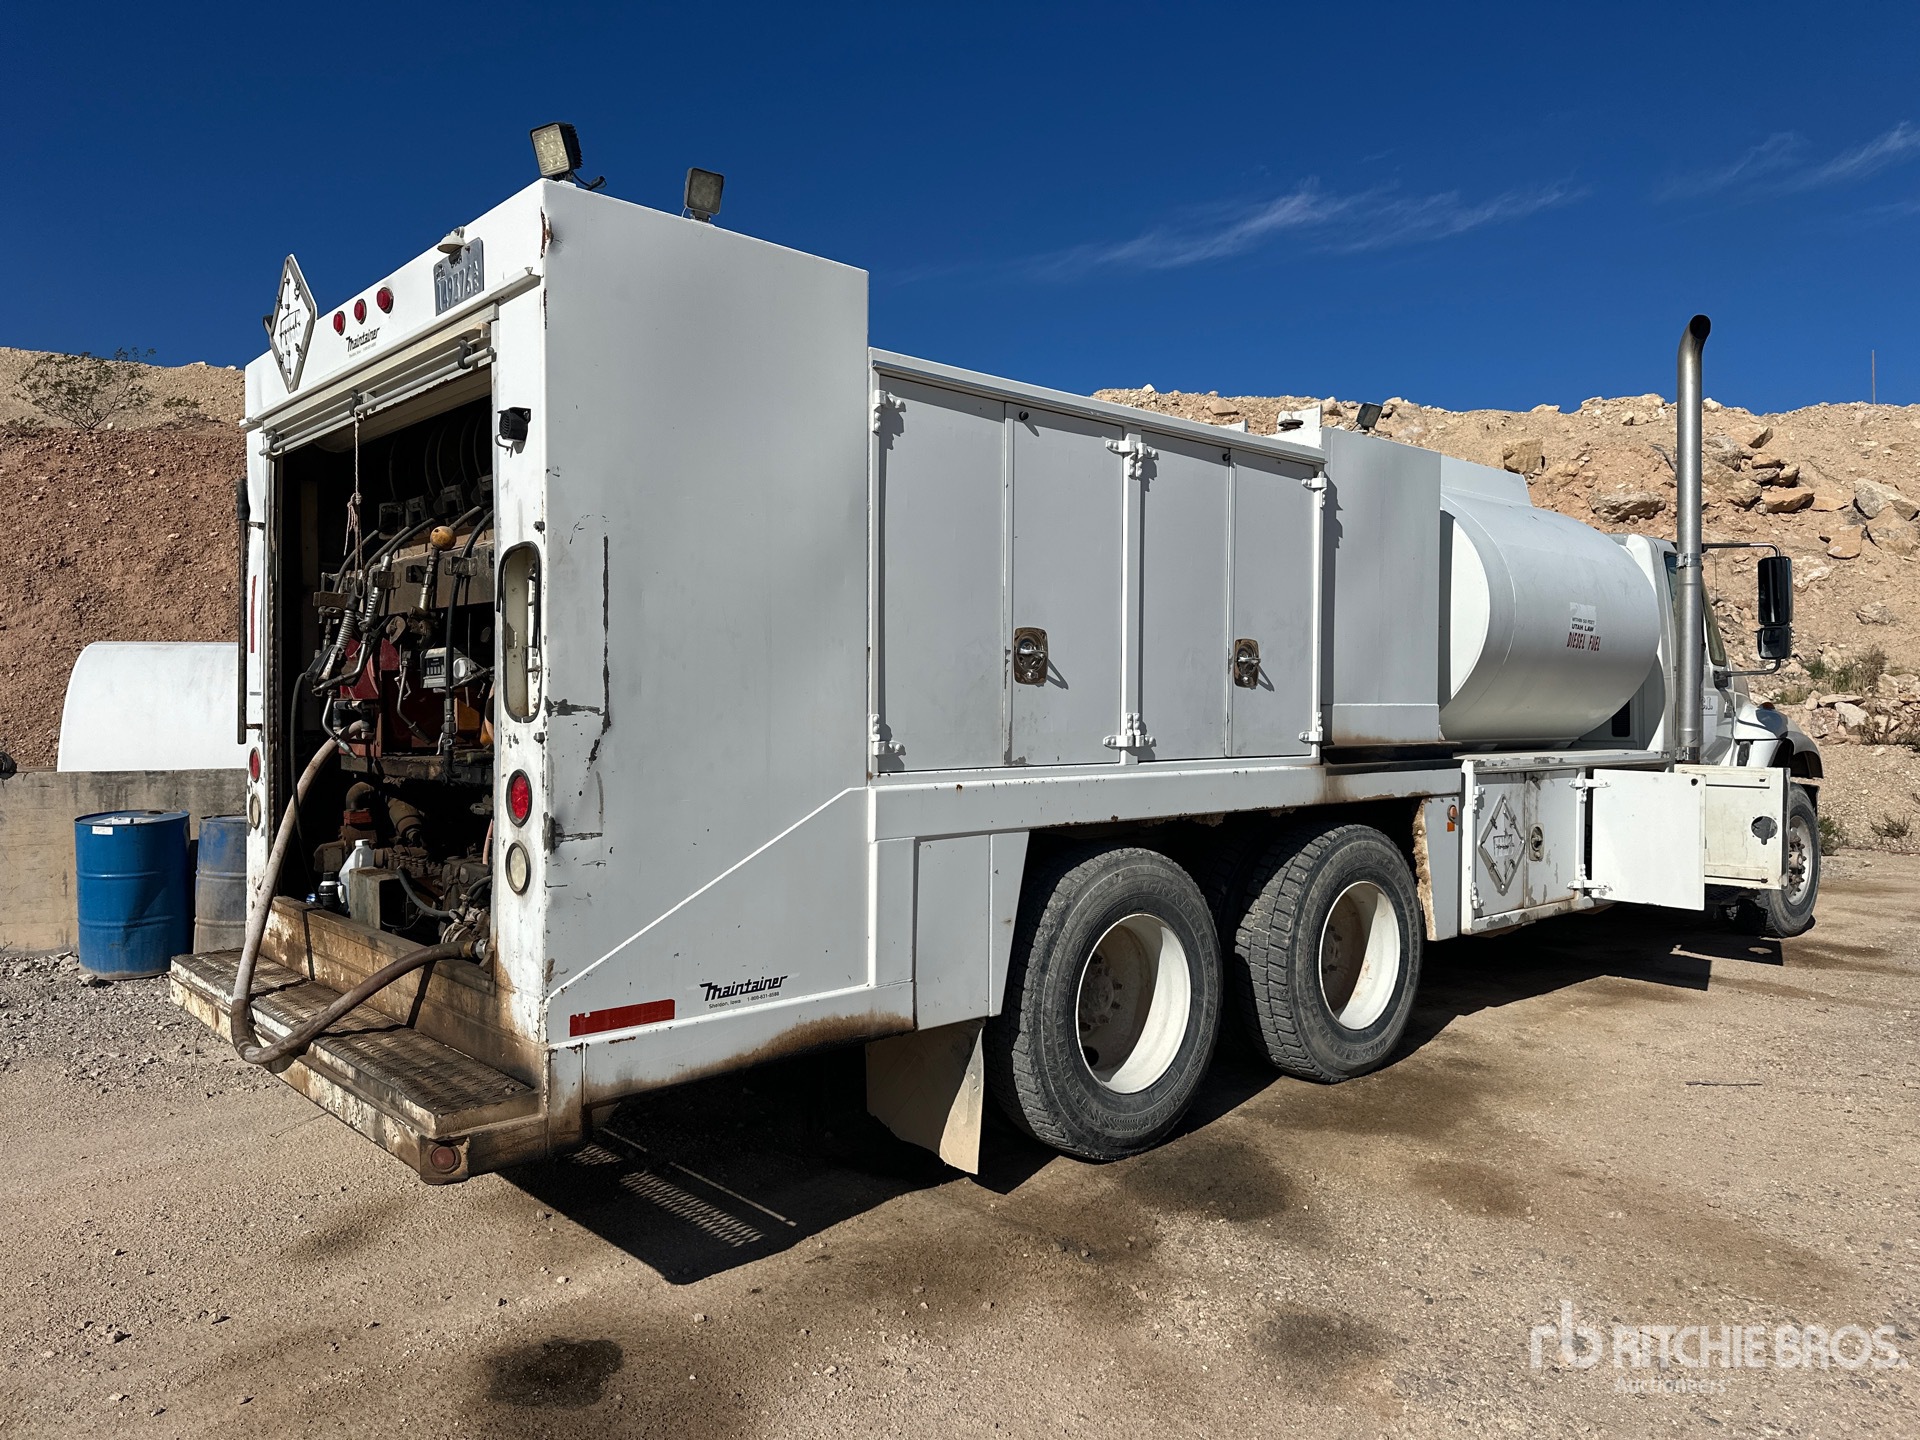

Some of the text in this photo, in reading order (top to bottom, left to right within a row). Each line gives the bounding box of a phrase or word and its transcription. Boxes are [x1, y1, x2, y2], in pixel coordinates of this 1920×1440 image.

[346, 327, 381, 352] Maintainer
[1567, 632, 1601, 651] DIESEL FUEL
[699, 975, 788, 1001] Maintainer
[708, 1002, 729, 1010] Sheldon,
